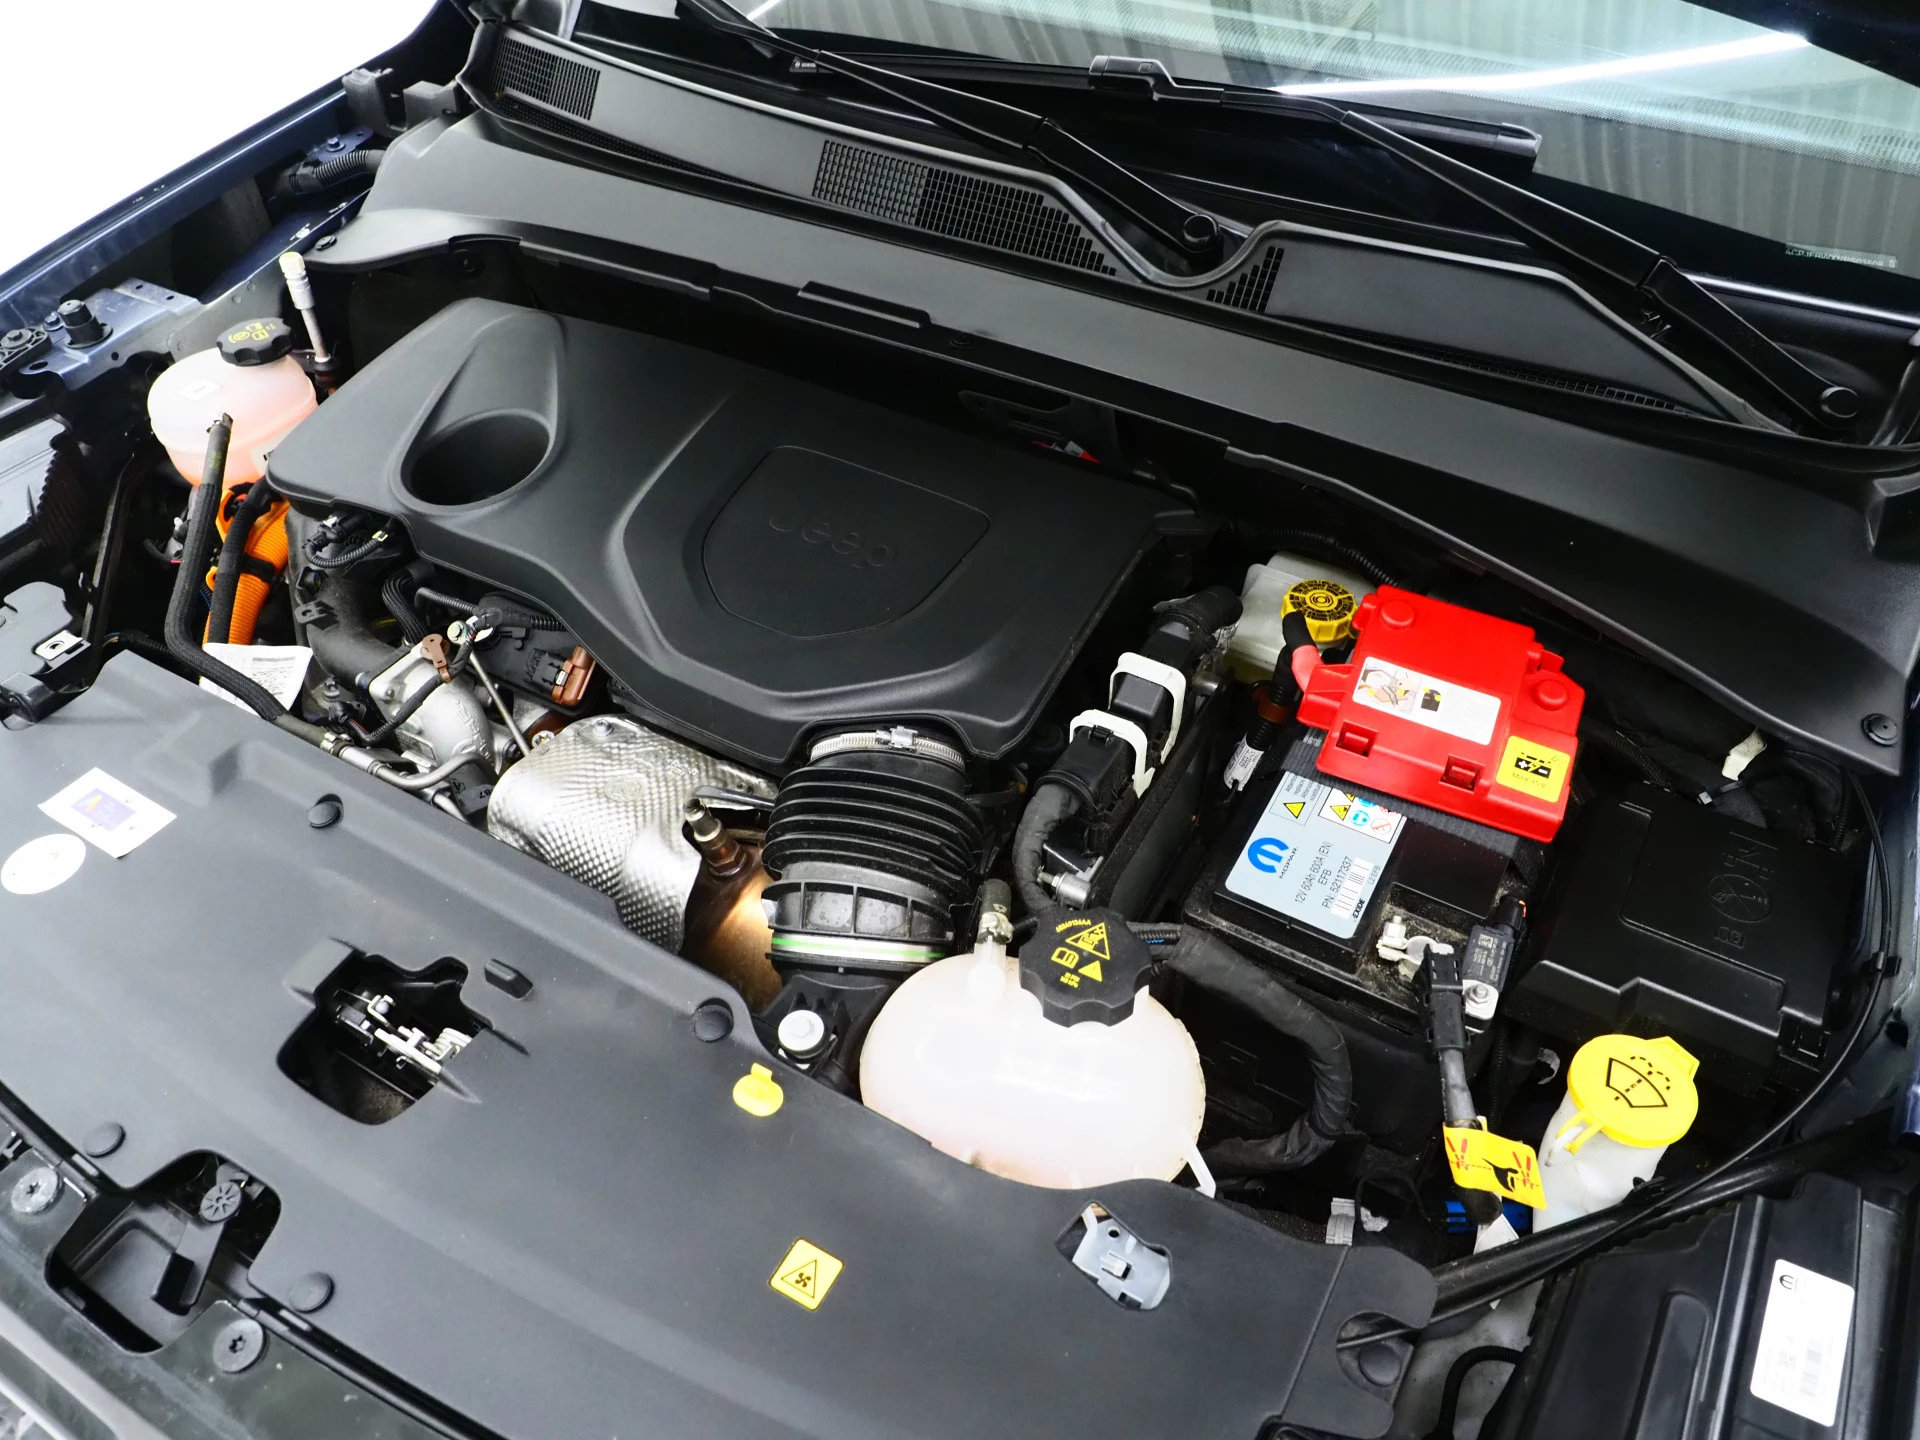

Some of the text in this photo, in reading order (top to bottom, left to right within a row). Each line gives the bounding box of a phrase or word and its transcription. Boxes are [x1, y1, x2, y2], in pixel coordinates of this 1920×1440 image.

[769, 507, 898, 568] Jeep
[1295, 840, 1335, 904] 12V 60Ah 600A (EN)
[1318, 868, 1332, 886] EFB
[1330, 855, 1353, 893] 52117337
[1352, 897, 1366, 919] EXIDE
